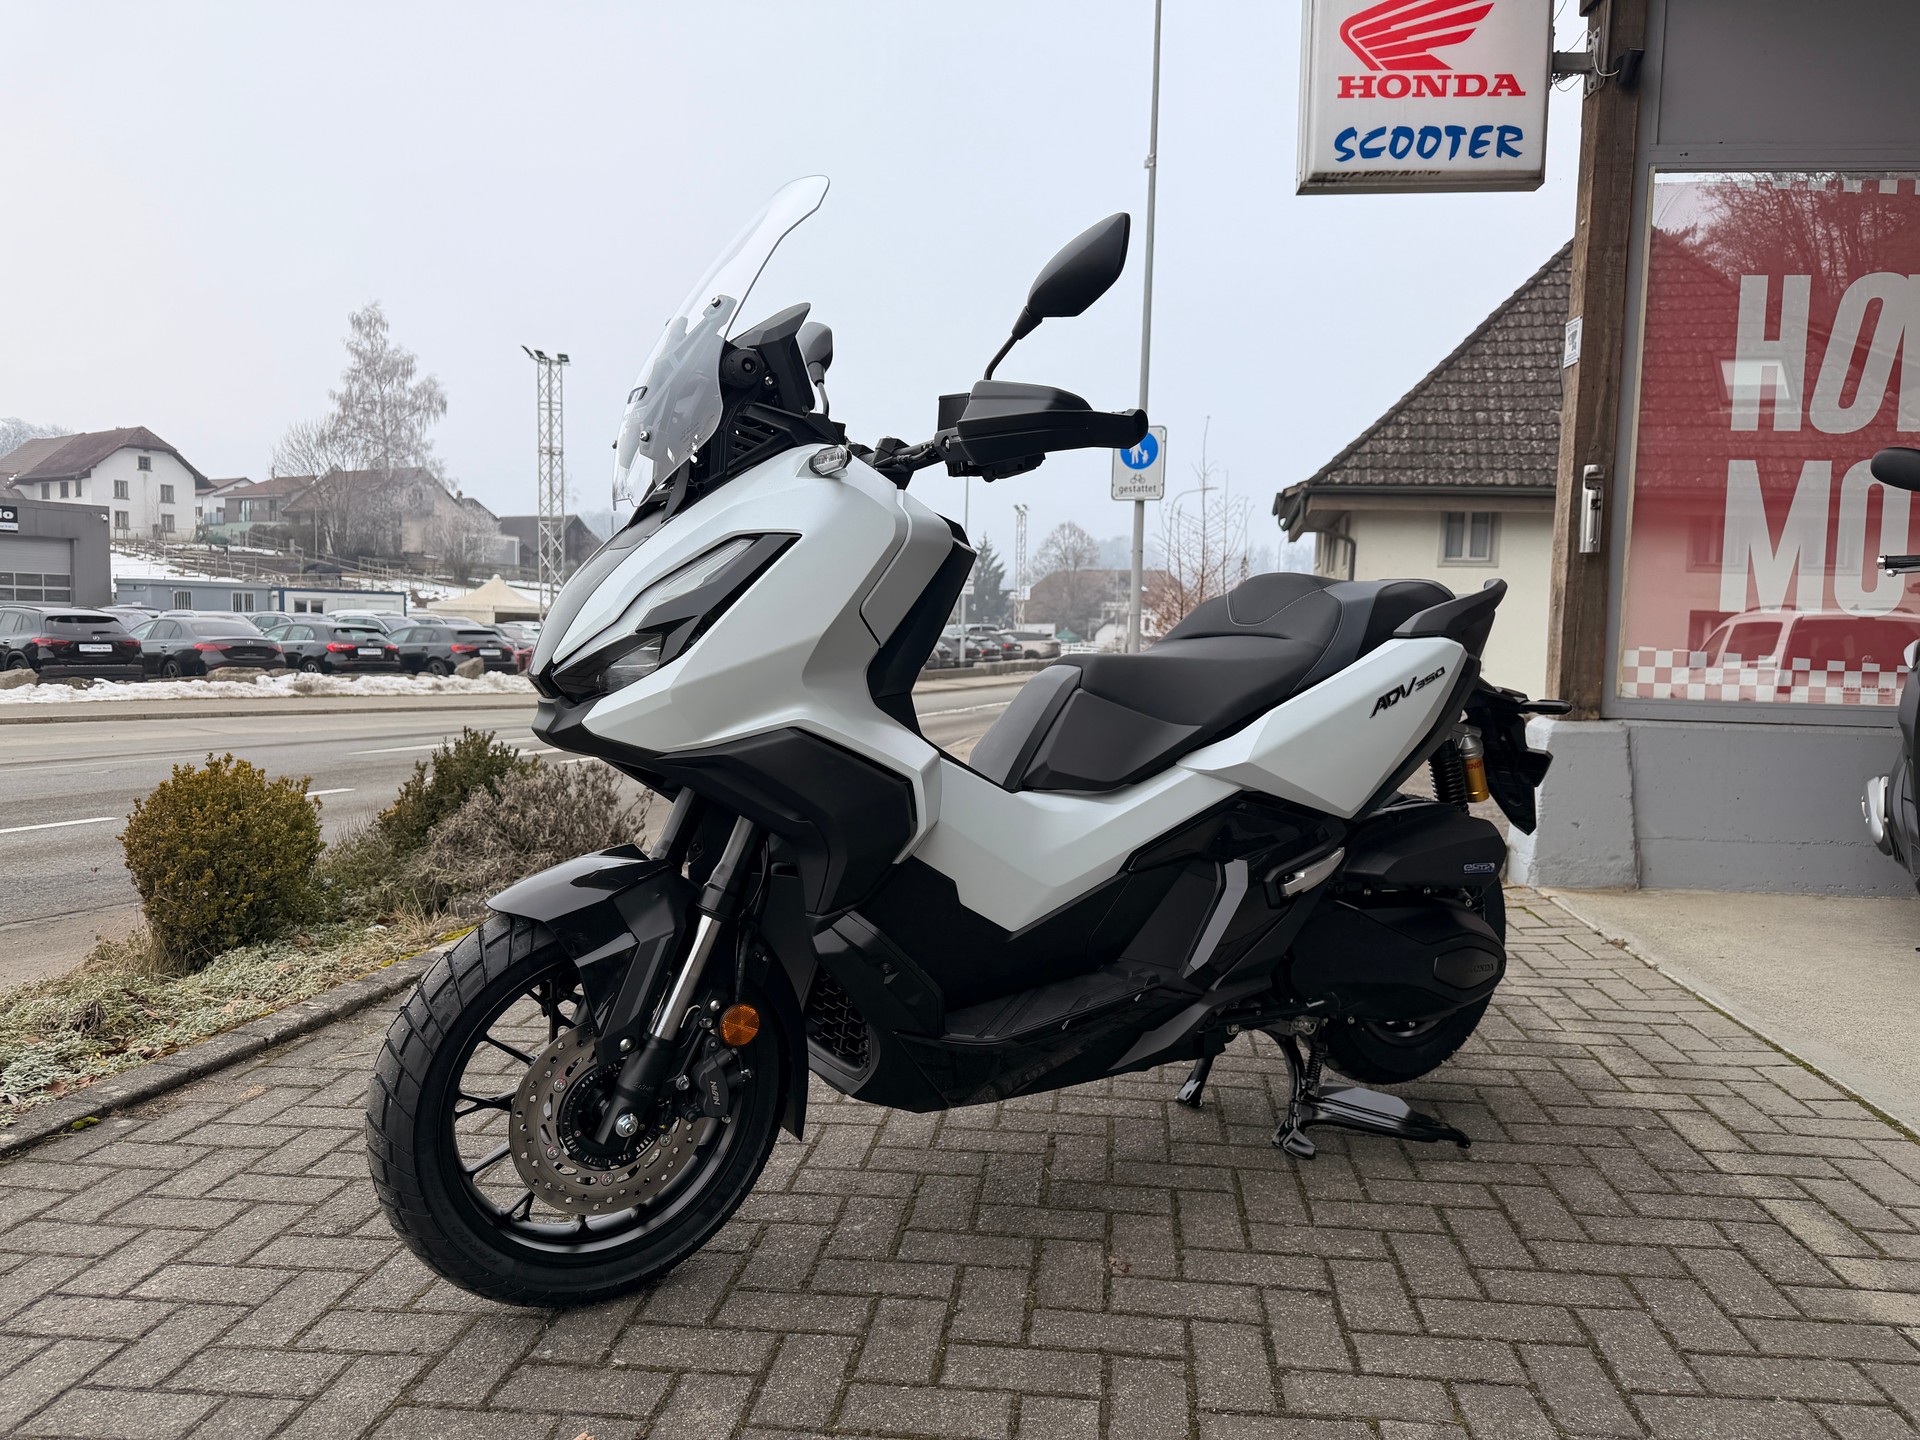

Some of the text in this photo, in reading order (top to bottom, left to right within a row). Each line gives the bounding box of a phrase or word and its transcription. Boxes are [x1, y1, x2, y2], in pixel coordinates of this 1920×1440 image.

[1337, 73, 1527, 99] HONDA
[1333, 124, 1524, 162] SCOOTER
[1118, 484, 1157, 495] gestattet
